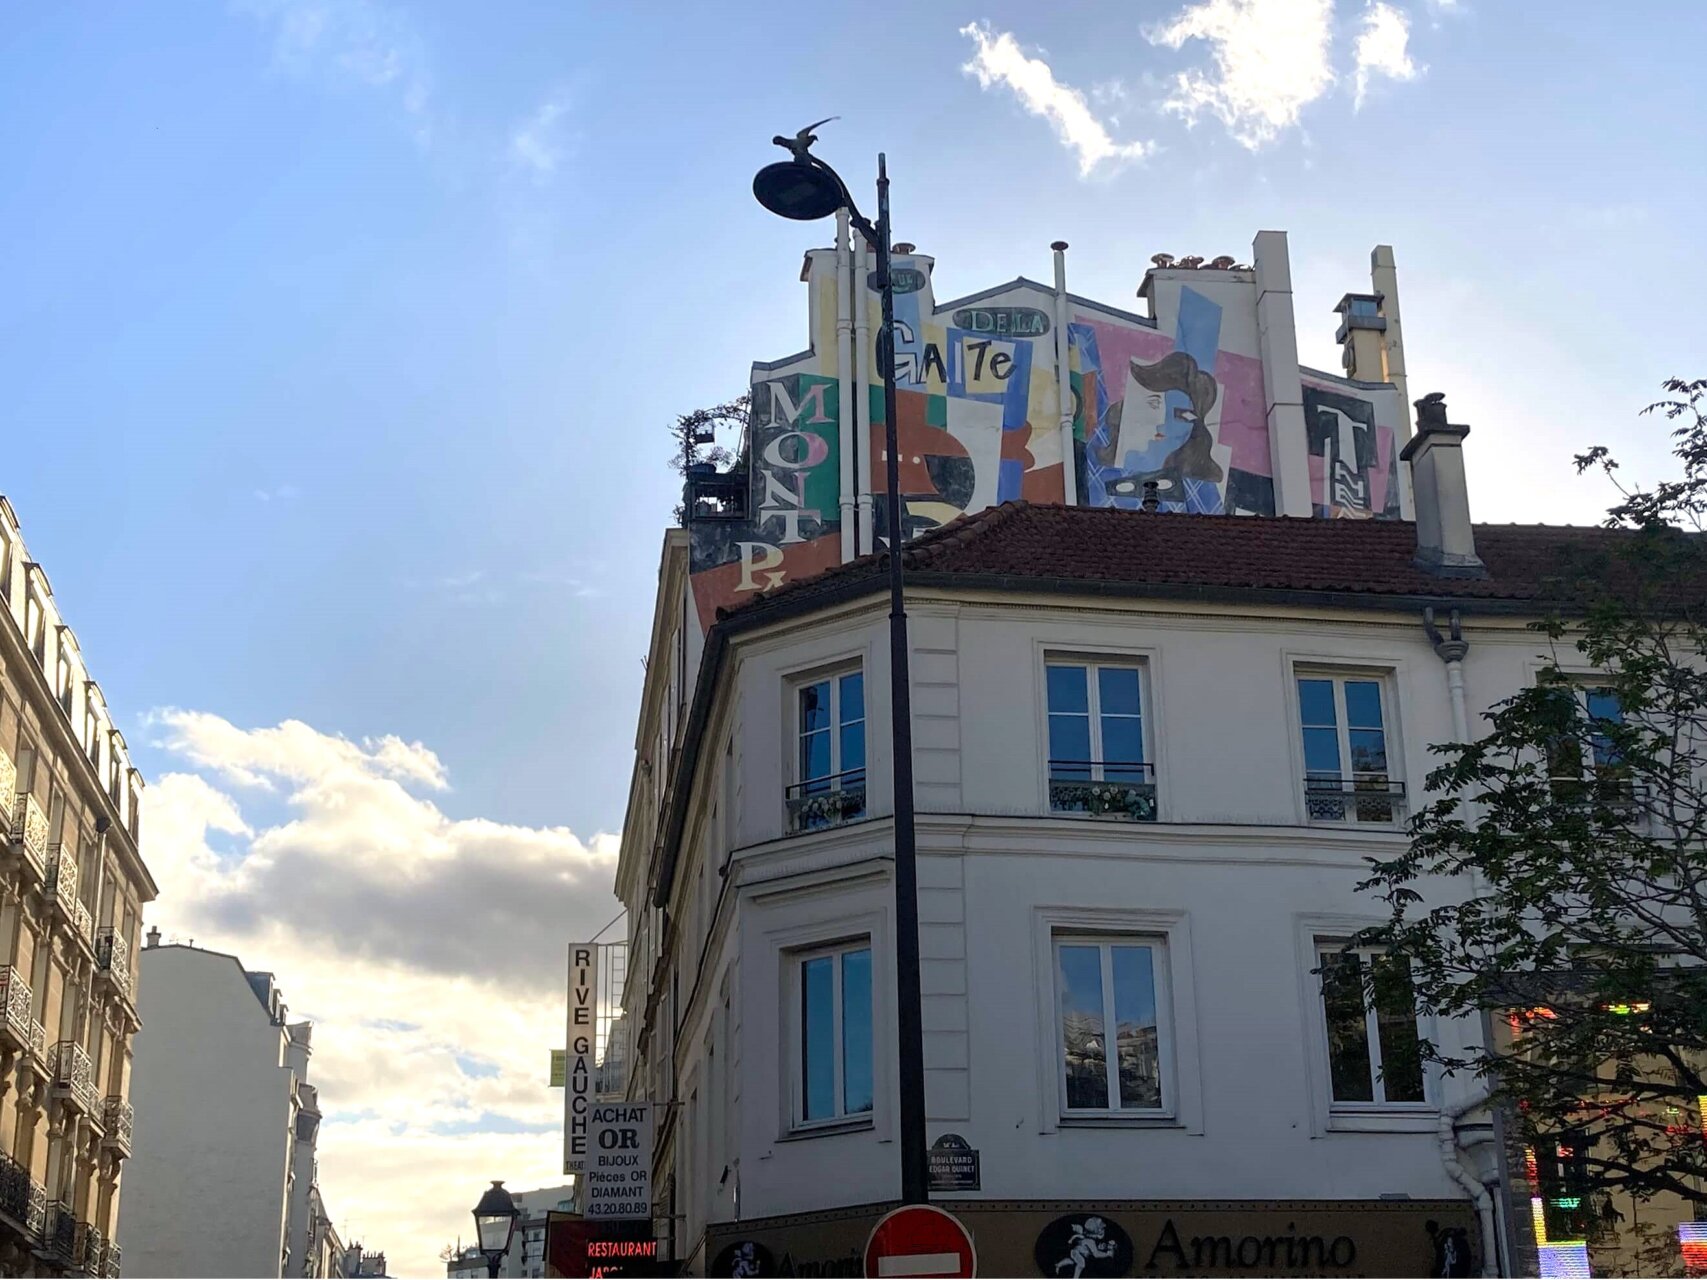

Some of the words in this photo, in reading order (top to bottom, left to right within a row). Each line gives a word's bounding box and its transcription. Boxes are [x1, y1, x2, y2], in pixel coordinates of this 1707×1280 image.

[574, 949, 591, 1026] RIVE
[571, 1036, 590, 1155] GAUCHE
[591, 1107, 647, 1123] ACHAT
[598, 1129, 640, 1148] OR
[598, 1155, 639, 1167] BIJOUX
[930, 1156, 973, 1164] BOULEVARD
[588, 1170, 626, 1183] Pièces
[630, 1171, 648, 1182] OR
[929, 1165, 950, 1173] EDGAR
[951, 1165, 975, 1173] QUINET
[591, 1187, 644, 1199] DIAMANT
[587, 1241, 657, 1257] RESTAURANT
[1145, 1219, 1356, 1269] Amorino
